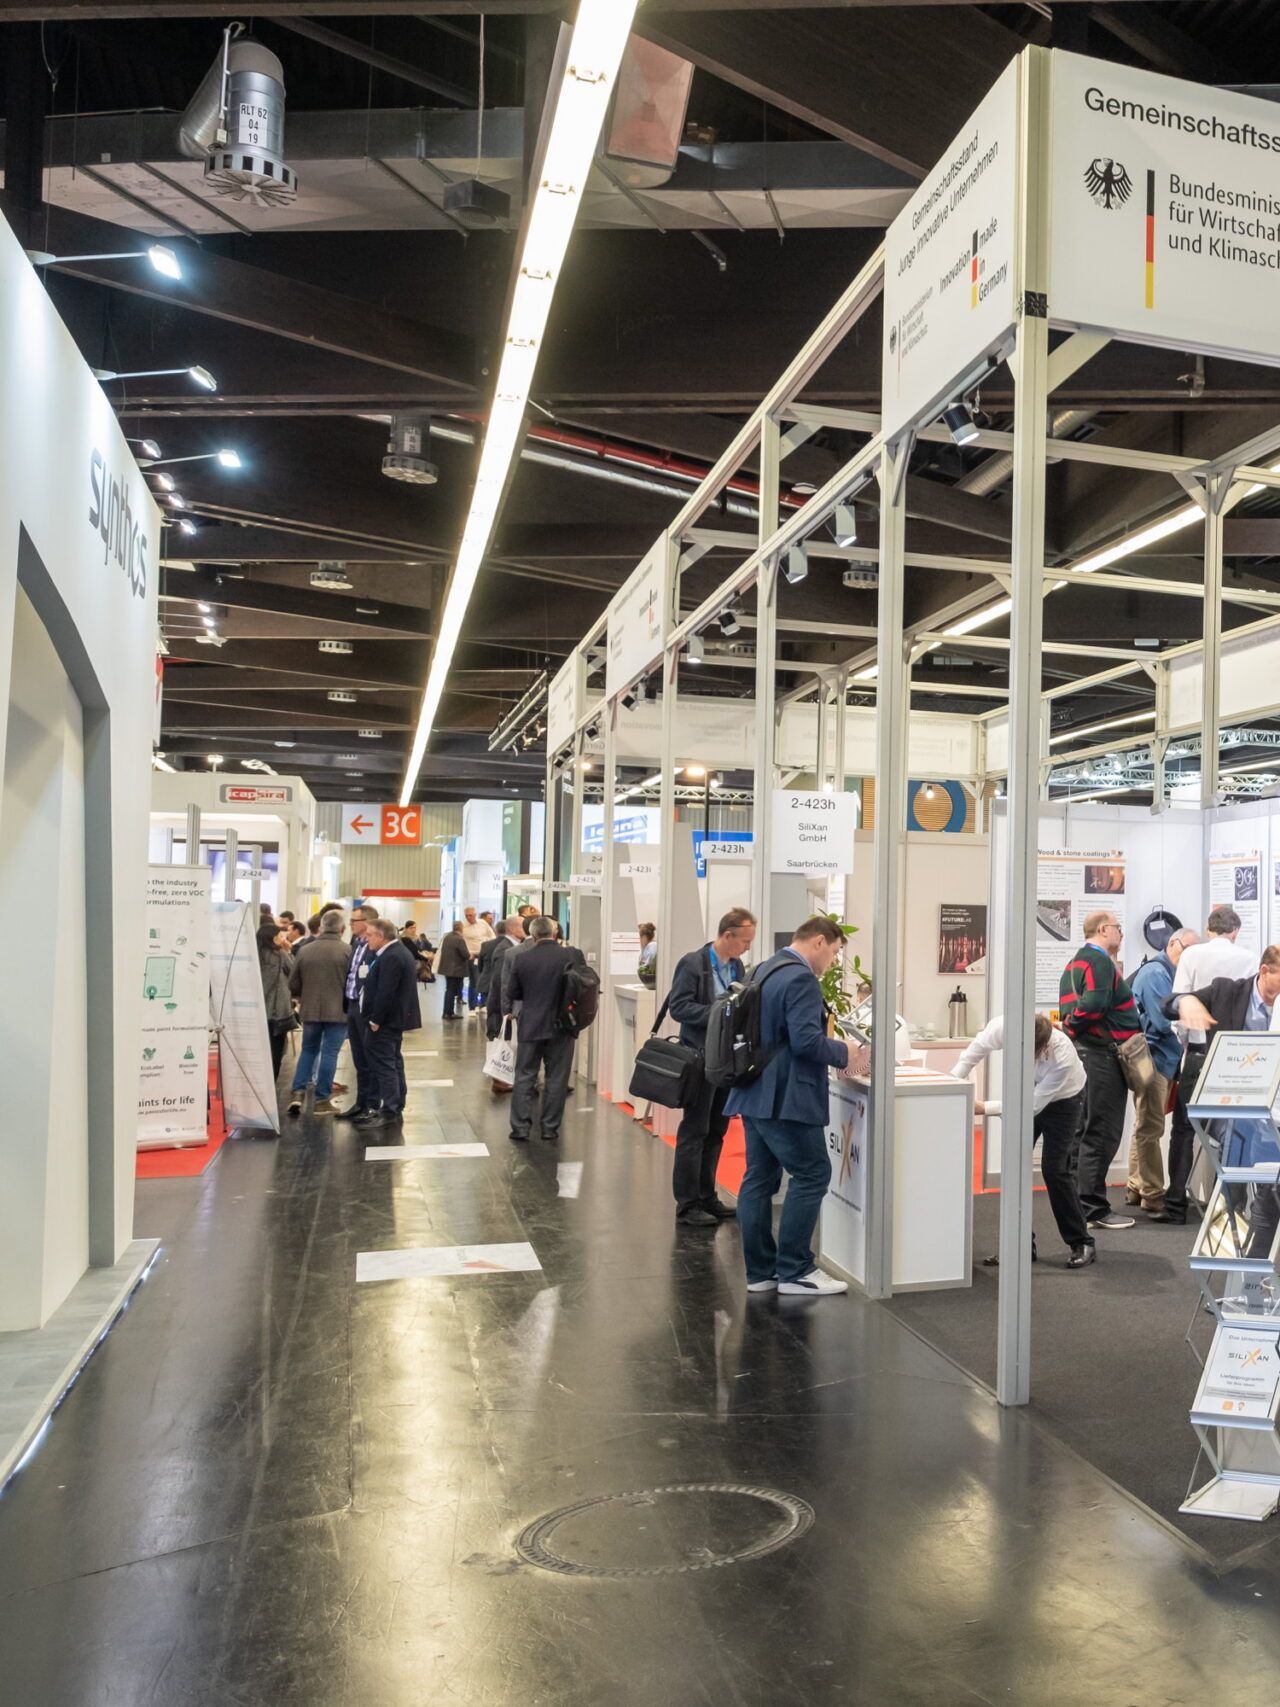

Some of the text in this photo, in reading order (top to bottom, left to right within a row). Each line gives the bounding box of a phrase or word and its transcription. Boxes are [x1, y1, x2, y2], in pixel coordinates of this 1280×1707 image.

[241, 104, 268, 119] RLT 62
[248, 119, 259, 130] 04
[248, 133, 259, 144] 19
[911, 129, 979, 231] Gemeinschaftsstand
[916, 205, 949, 254] innovative
[949, 140, 999, 213] Unternehmen
[1169, 200, 1195, 225] für
[1168, 233, 1202, 255] und
[978, 260, 1009, 302] Germany
[791, 797, 836, 810] 2-423h
[385, 811, 417, 838] 3C
[798, 823, 828, 832] SiliXan
[798, 833, 827, 842] GmbH
[711, 844, 745, 853] 2-423h
[1082, 850, 1111, 858] coatings
[786, 859, 838, 868] Saarbrücken
[166, 879, 198, 887] industry
[162, 1097, 177, 1105] for
[179, 1096, 196, 1105] life
